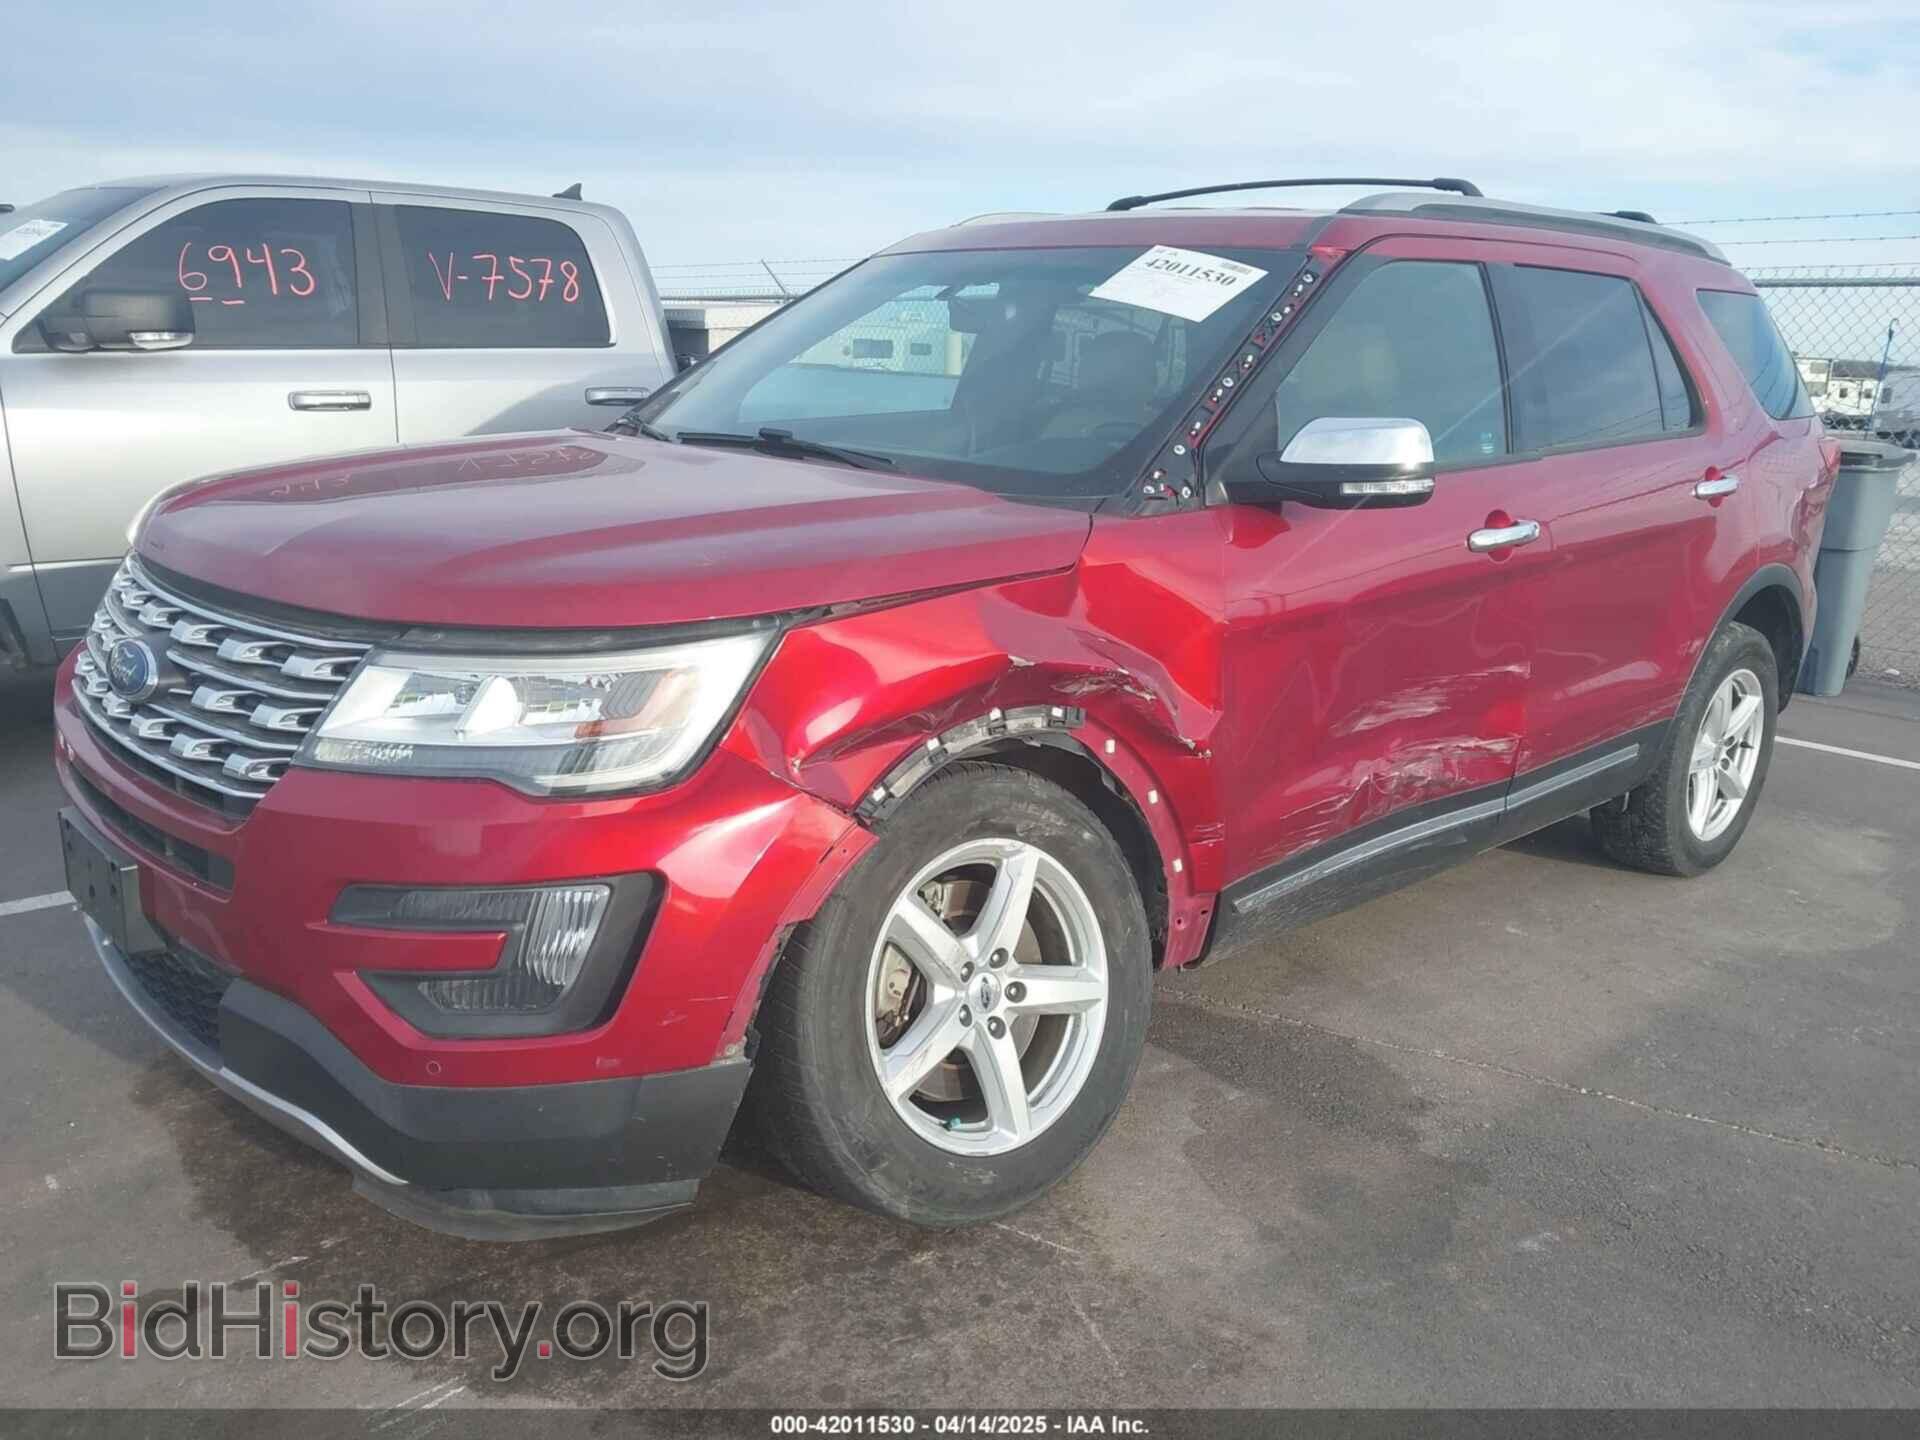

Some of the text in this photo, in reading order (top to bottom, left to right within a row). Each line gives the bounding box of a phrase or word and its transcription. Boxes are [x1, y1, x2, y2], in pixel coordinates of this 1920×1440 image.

[178, 241, 317, 300] 6943
[427, 251, 581, 304] V-7578
[1144, 256, 1238, 287] 42011530
